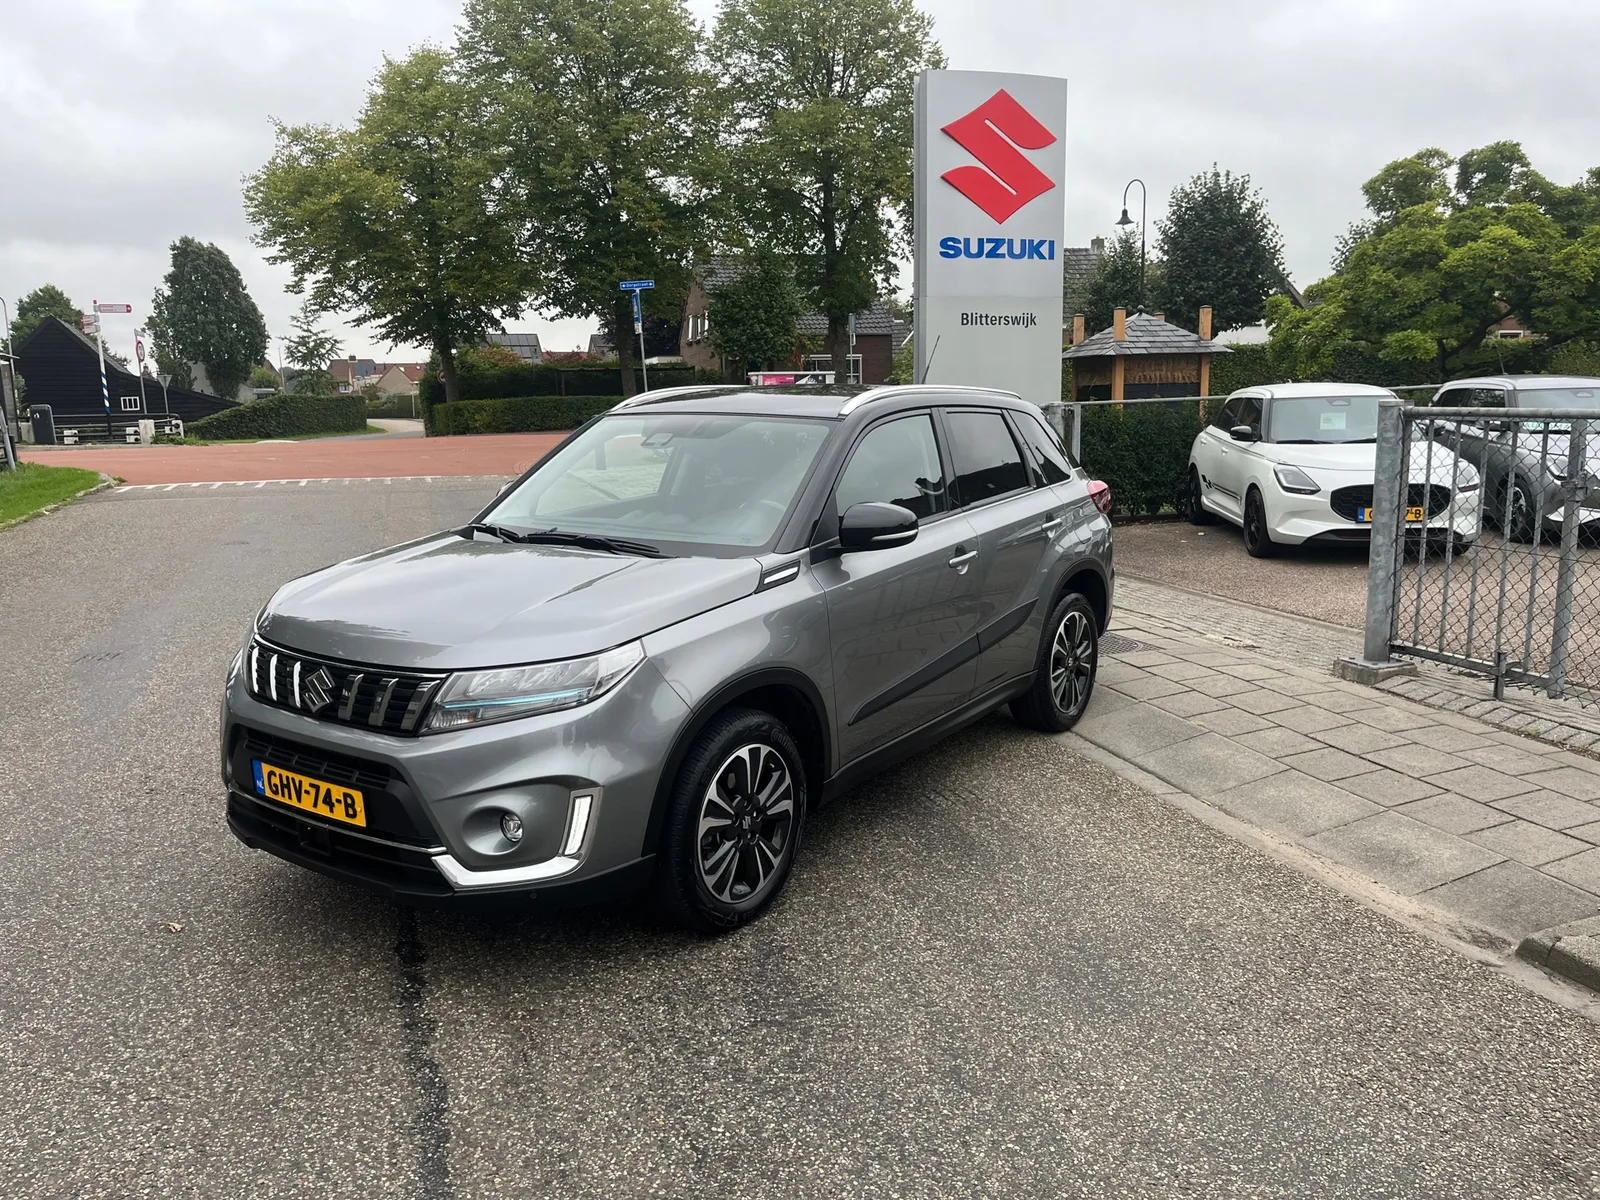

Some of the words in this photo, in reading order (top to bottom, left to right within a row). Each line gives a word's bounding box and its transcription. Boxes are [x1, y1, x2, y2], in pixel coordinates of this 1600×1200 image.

[939, 237, 1055, 260] SUZUKI
[961, 312, 1037, 328] Blitterswijk
[267, 770, 358, 819] GHV-74-B
